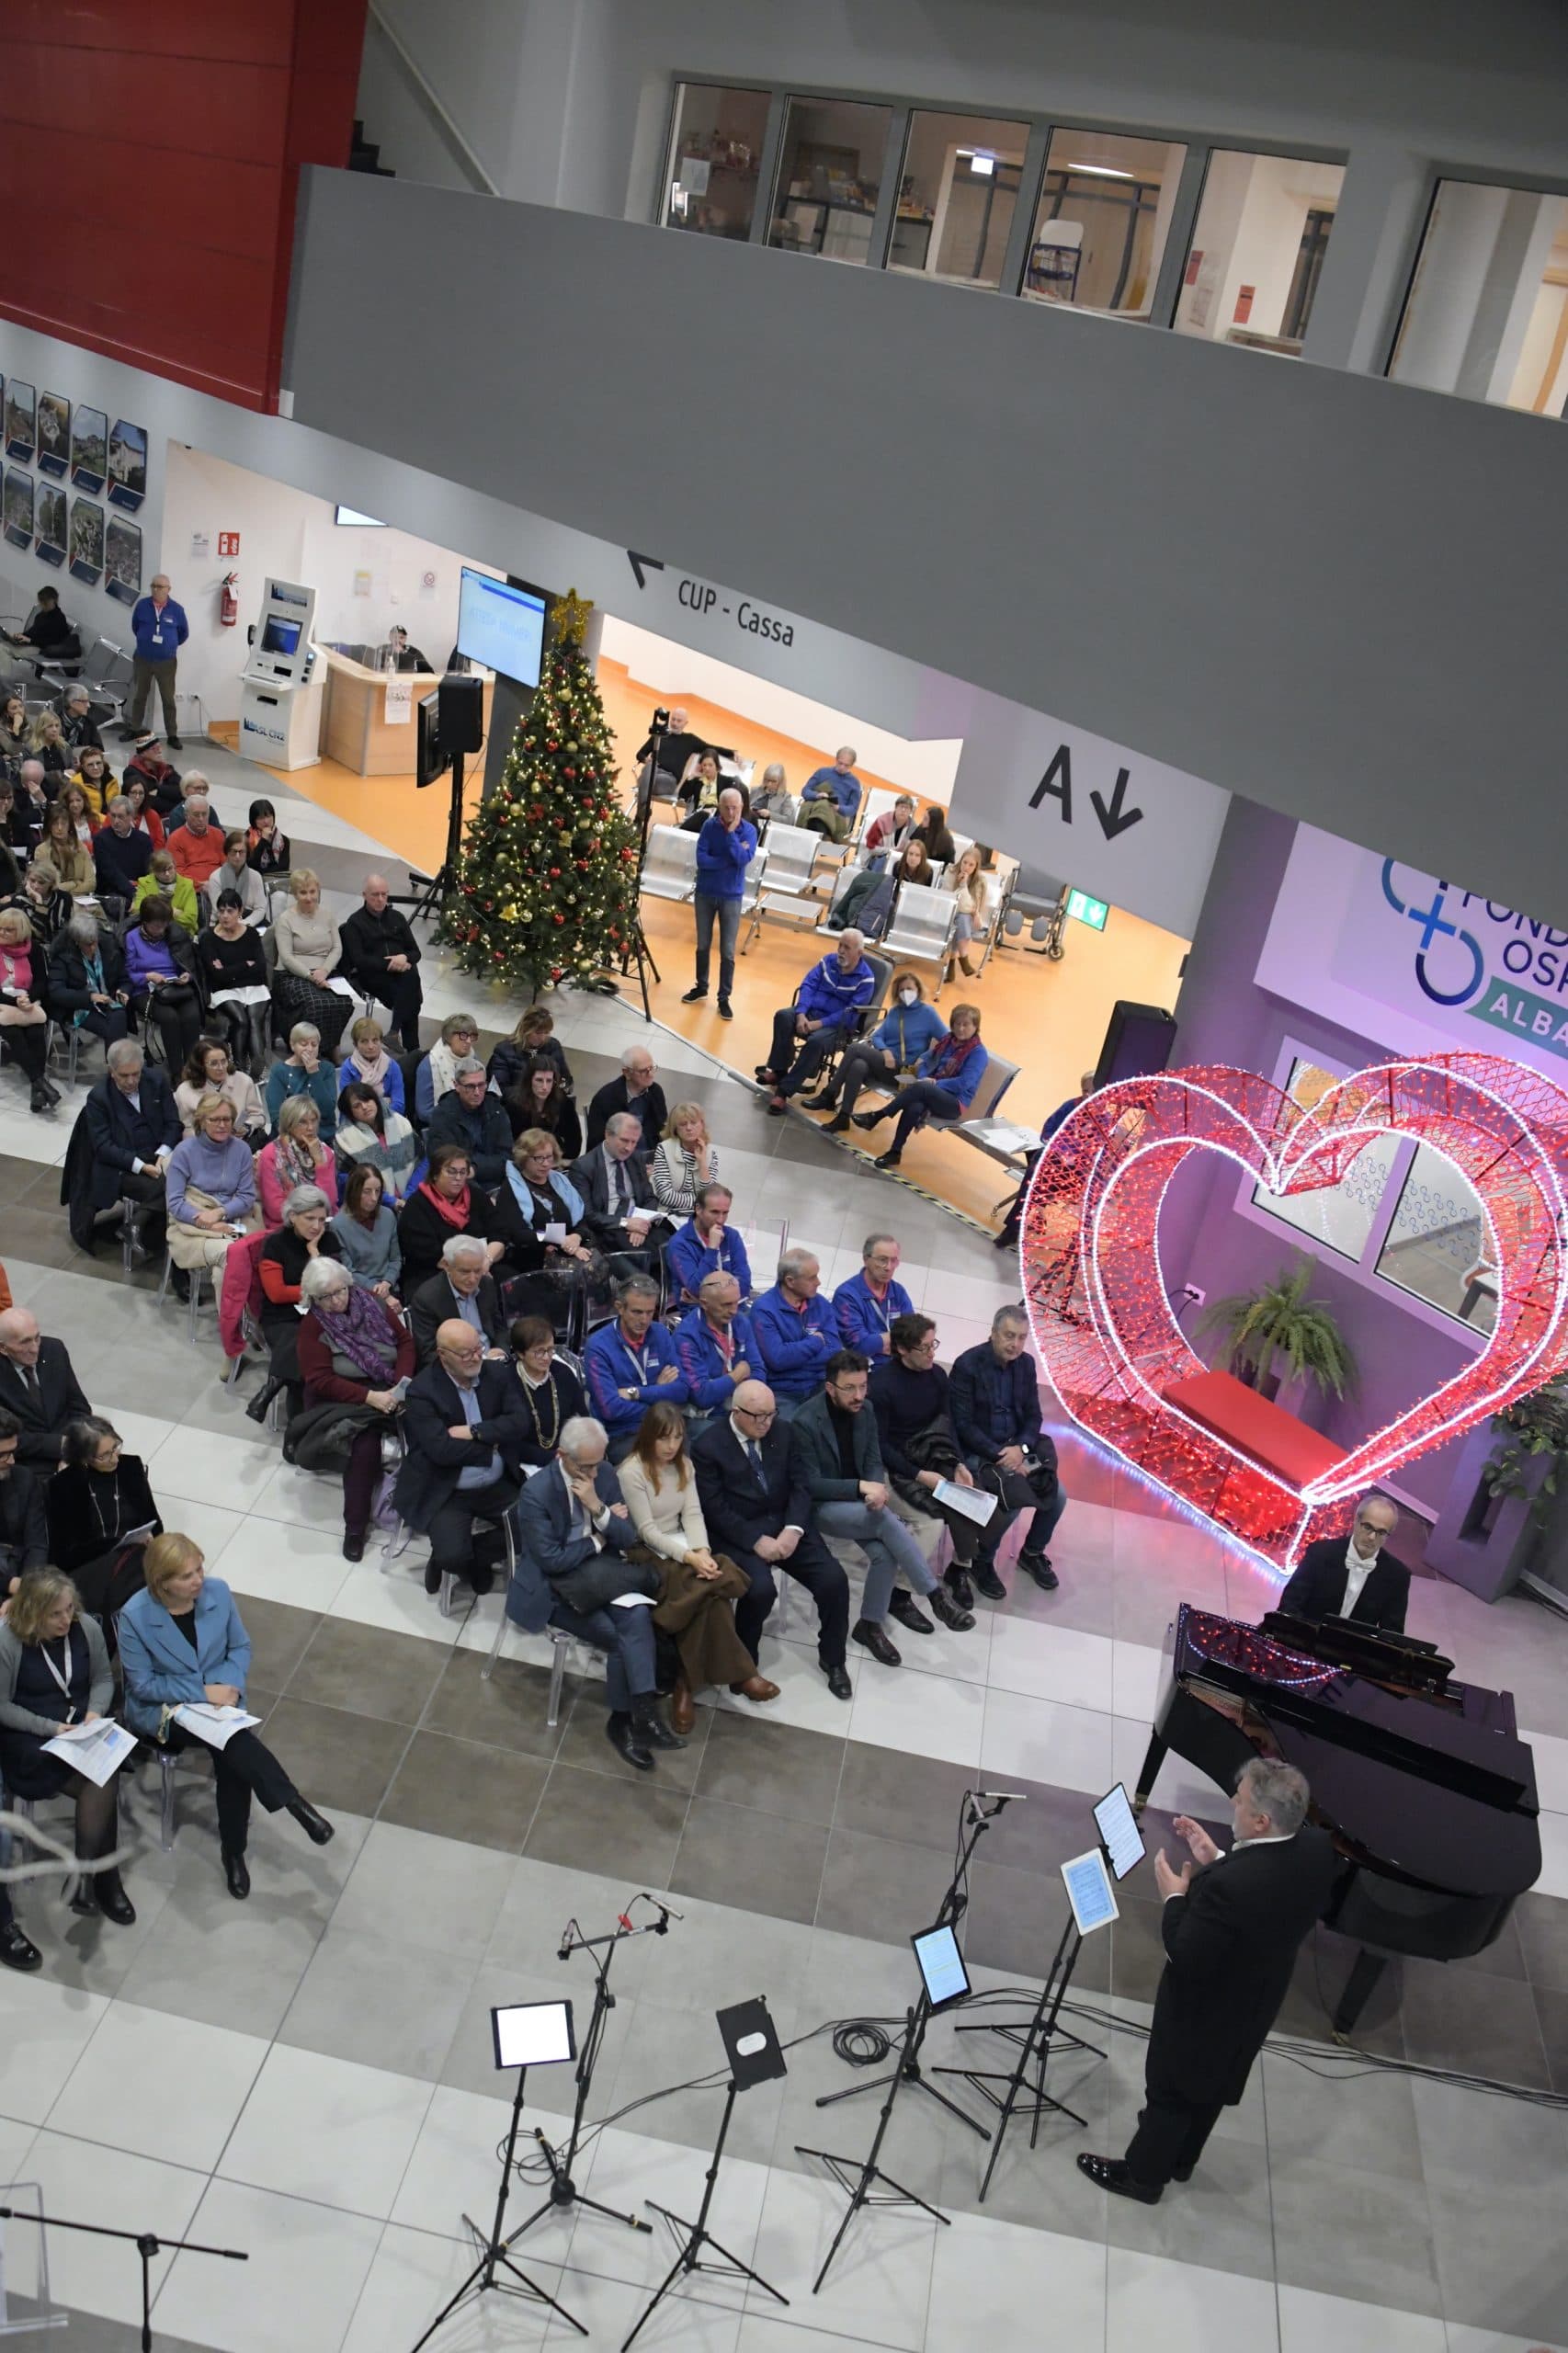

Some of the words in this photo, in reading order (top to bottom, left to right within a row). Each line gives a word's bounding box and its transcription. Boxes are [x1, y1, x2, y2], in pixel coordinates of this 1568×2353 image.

[678, 580, 716, 614] CUP
[737, 602, 794, 647] Cassa
[1028, 745, 1072, 824] A
